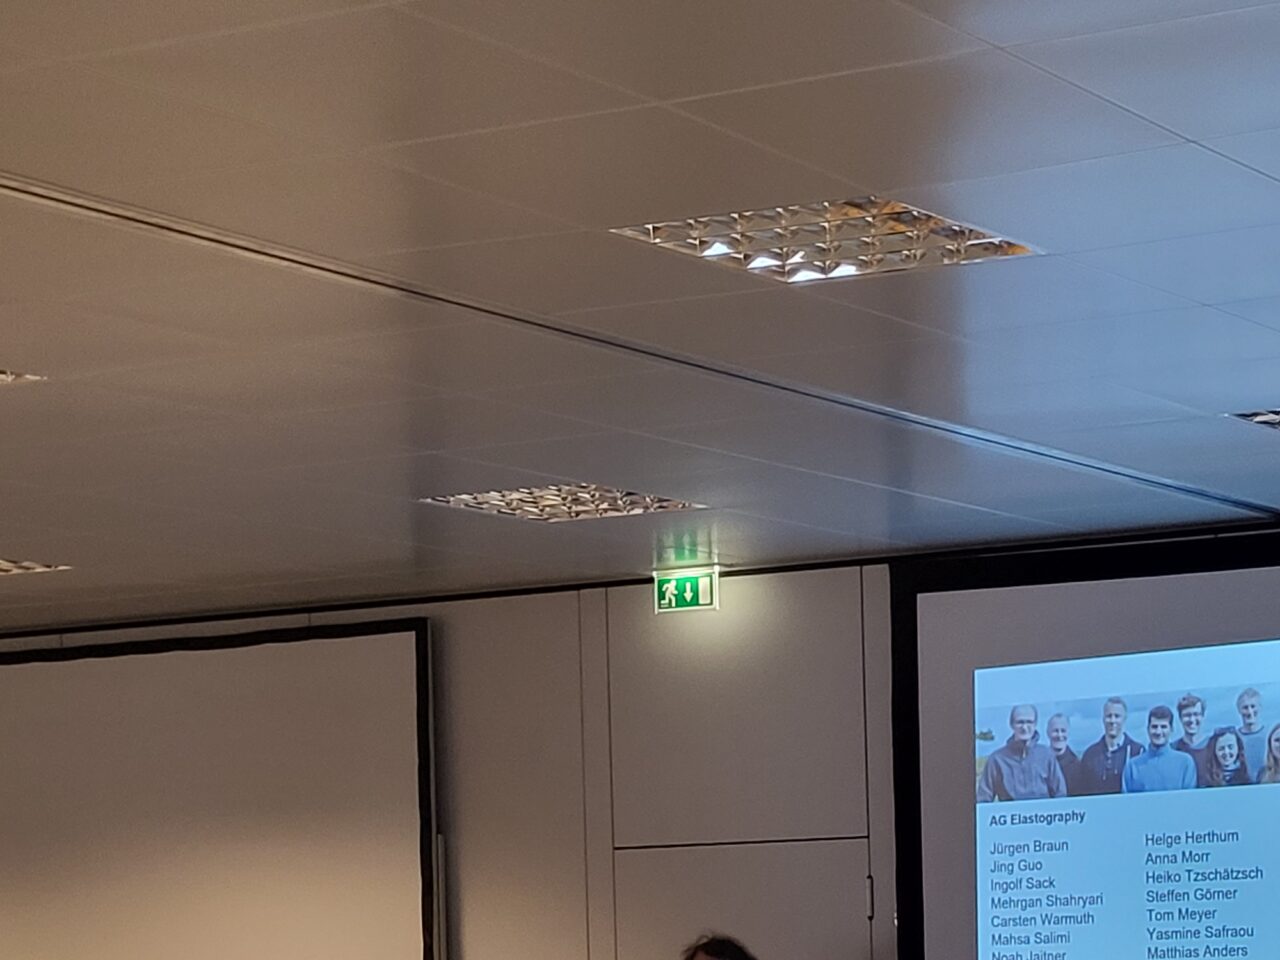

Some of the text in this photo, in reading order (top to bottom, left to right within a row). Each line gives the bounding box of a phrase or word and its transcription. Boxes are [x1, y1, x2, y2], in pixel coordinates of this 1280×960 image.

[989, 810, 1086, 827] AG Elastography
[1145, 829, 1239, 848] Helge Herthum
[990, 839, 1069, 857] Jürgen Braun
[1145, 850, 1211, 865] Anna Morr
[990, 859, 1042, 875] Jing Guo
[1145, 866, 1264, 884] Heiko Tzschätzsch
[990, 877, 1056, 893] Ingolf Sack
[991, 892, 1104, 911] Mehrgan Shahryari
[1146, 888, 1238, 903] Steffen Görner
[991, 912, 1095, 928] Carsten Warmuth
[1146, 907, 1218, 923] Tom Meyer
[991, 931, 1071, 946] Mahsa Salimi
[1147, 925, 1254, 941] Yasmine Safraou
[1147, 944, 1248, 960] Matthias Anders
